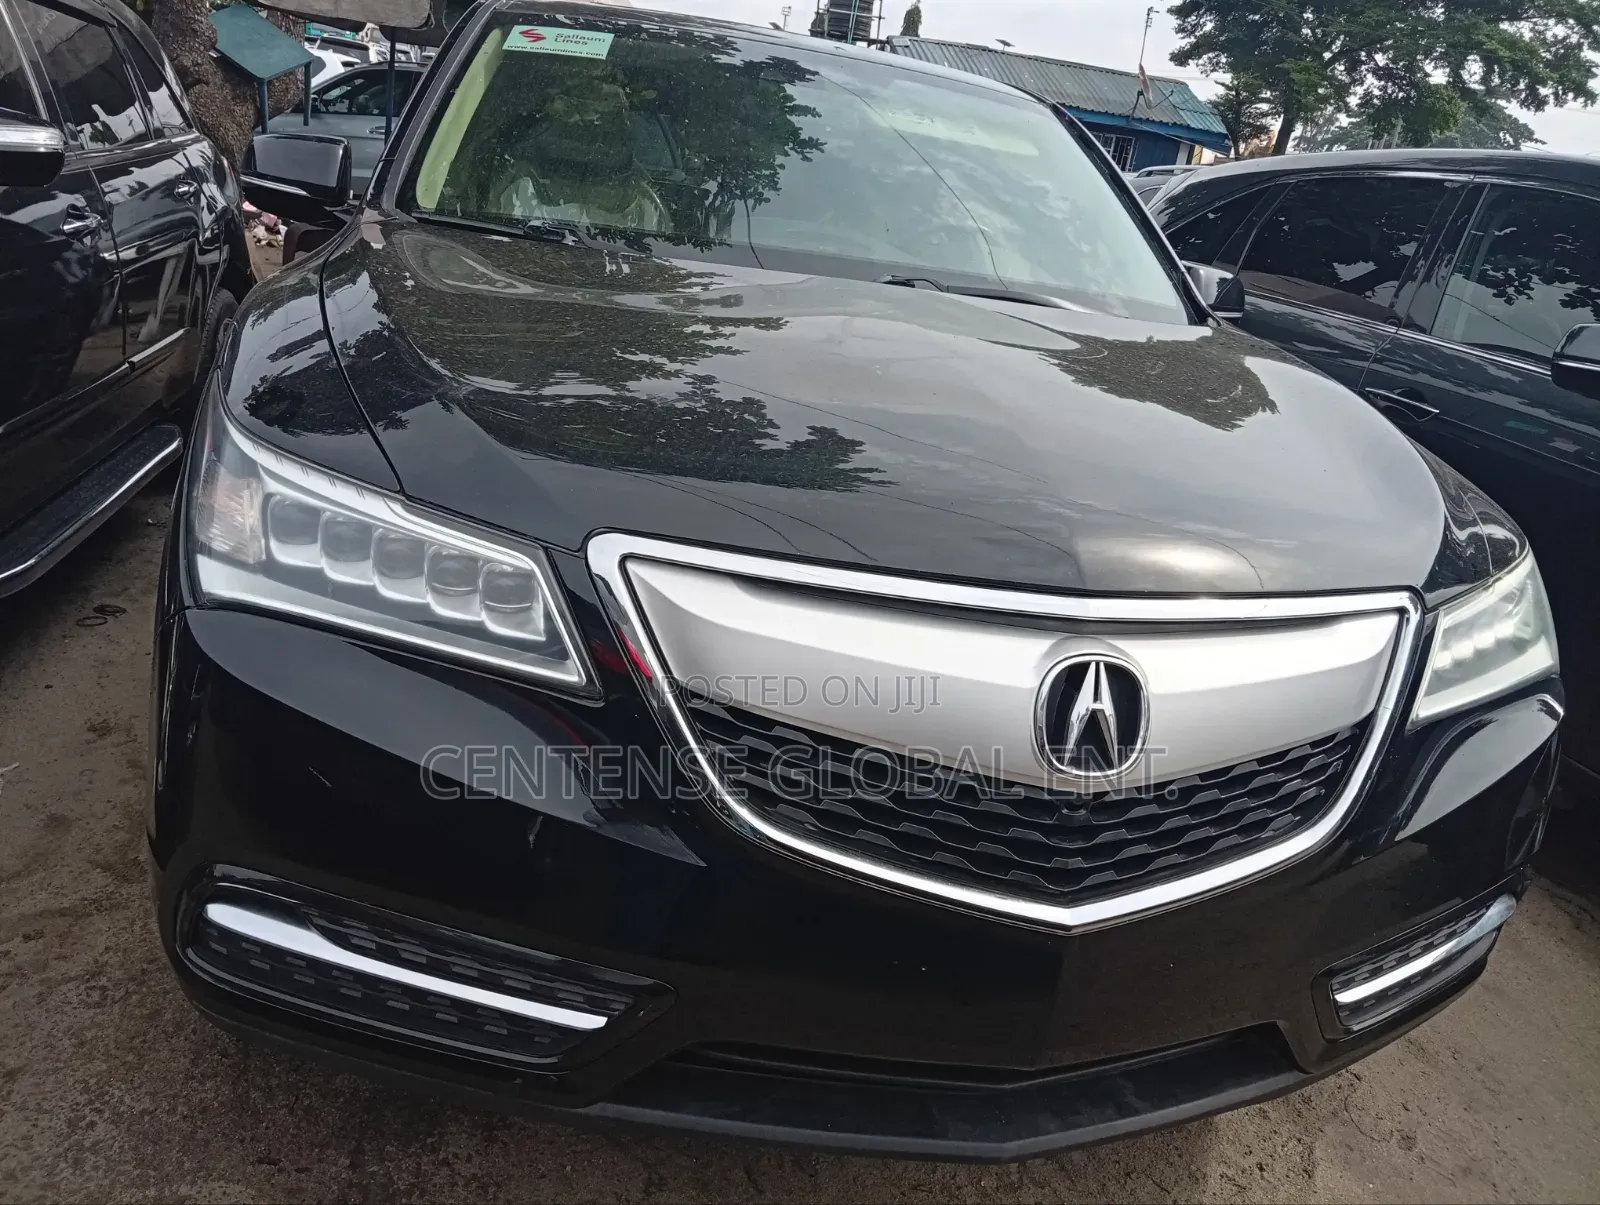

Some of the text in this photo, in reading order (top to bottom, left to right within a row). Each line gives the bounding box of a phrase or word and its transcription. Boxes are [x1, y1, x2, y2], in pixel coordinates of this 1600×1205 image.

[554, 37, 588, 46] Lines
[555, 33, 606, 43] Sallaum
[507, 45, 604, 57] www.sallaumlines.com
